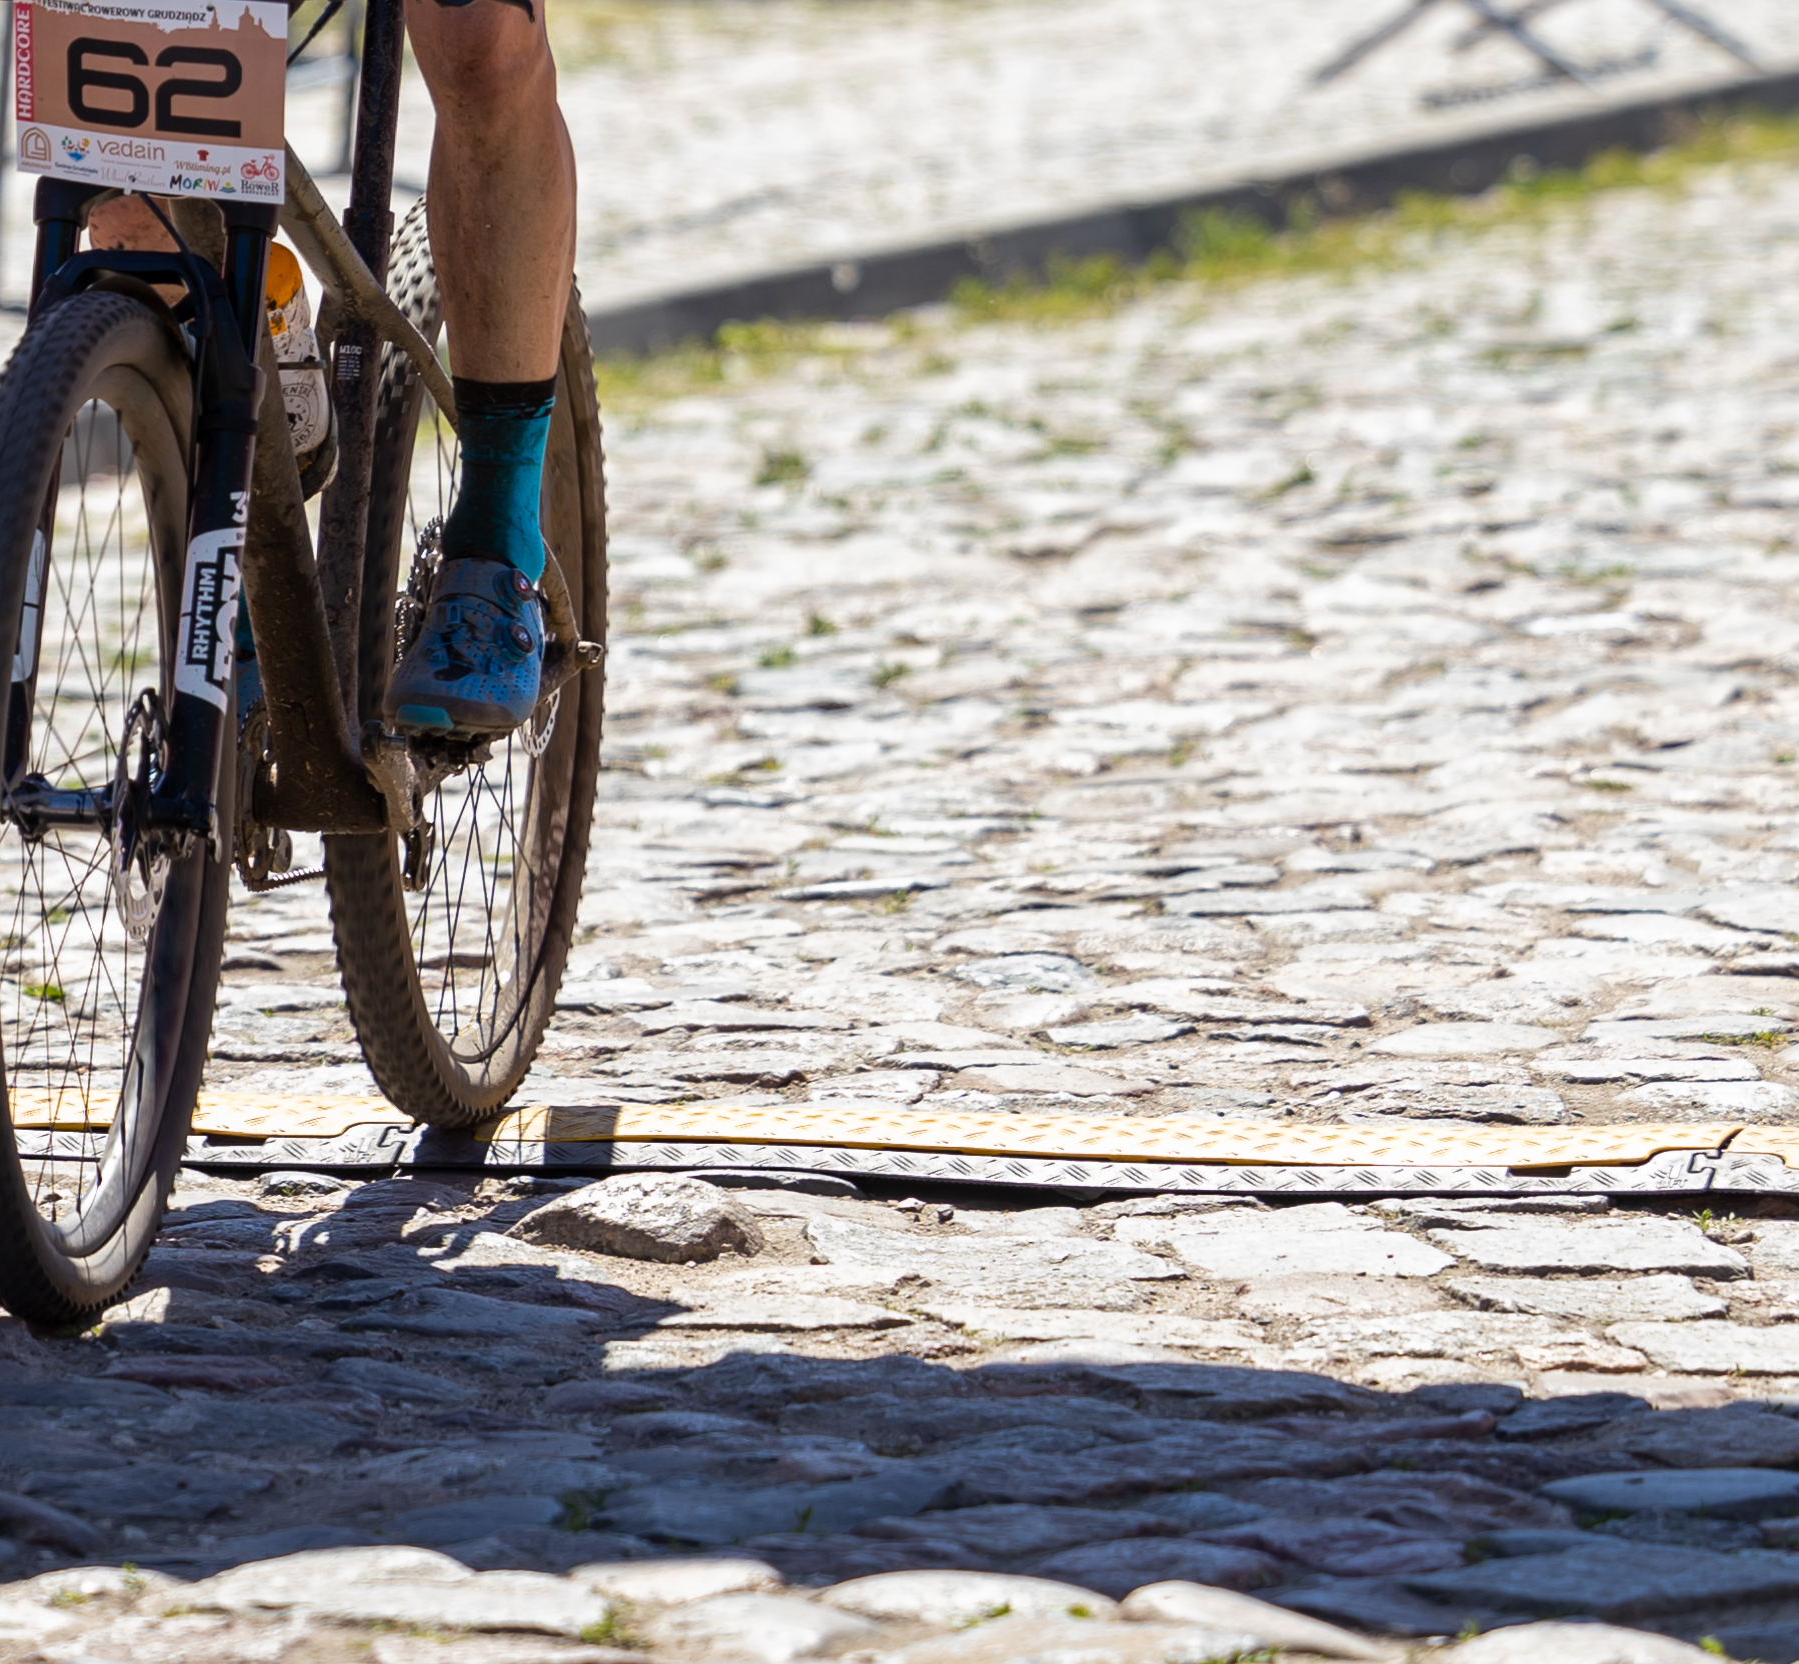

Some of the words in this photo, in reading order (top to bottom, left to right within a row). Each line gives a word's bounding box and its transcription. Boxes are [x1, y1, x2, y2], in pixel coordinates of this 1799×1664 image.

[88, 3, 146, 19] ROWEROWY
[147, 8, 207, 24] GRUDZIĄDZ
[16, 7, 31, 119] HARDCORE
[67, 37, 243, 139] 62
[97, 139, 166, 161] vadain
[191, 567, 217, 660] RHYTHM
